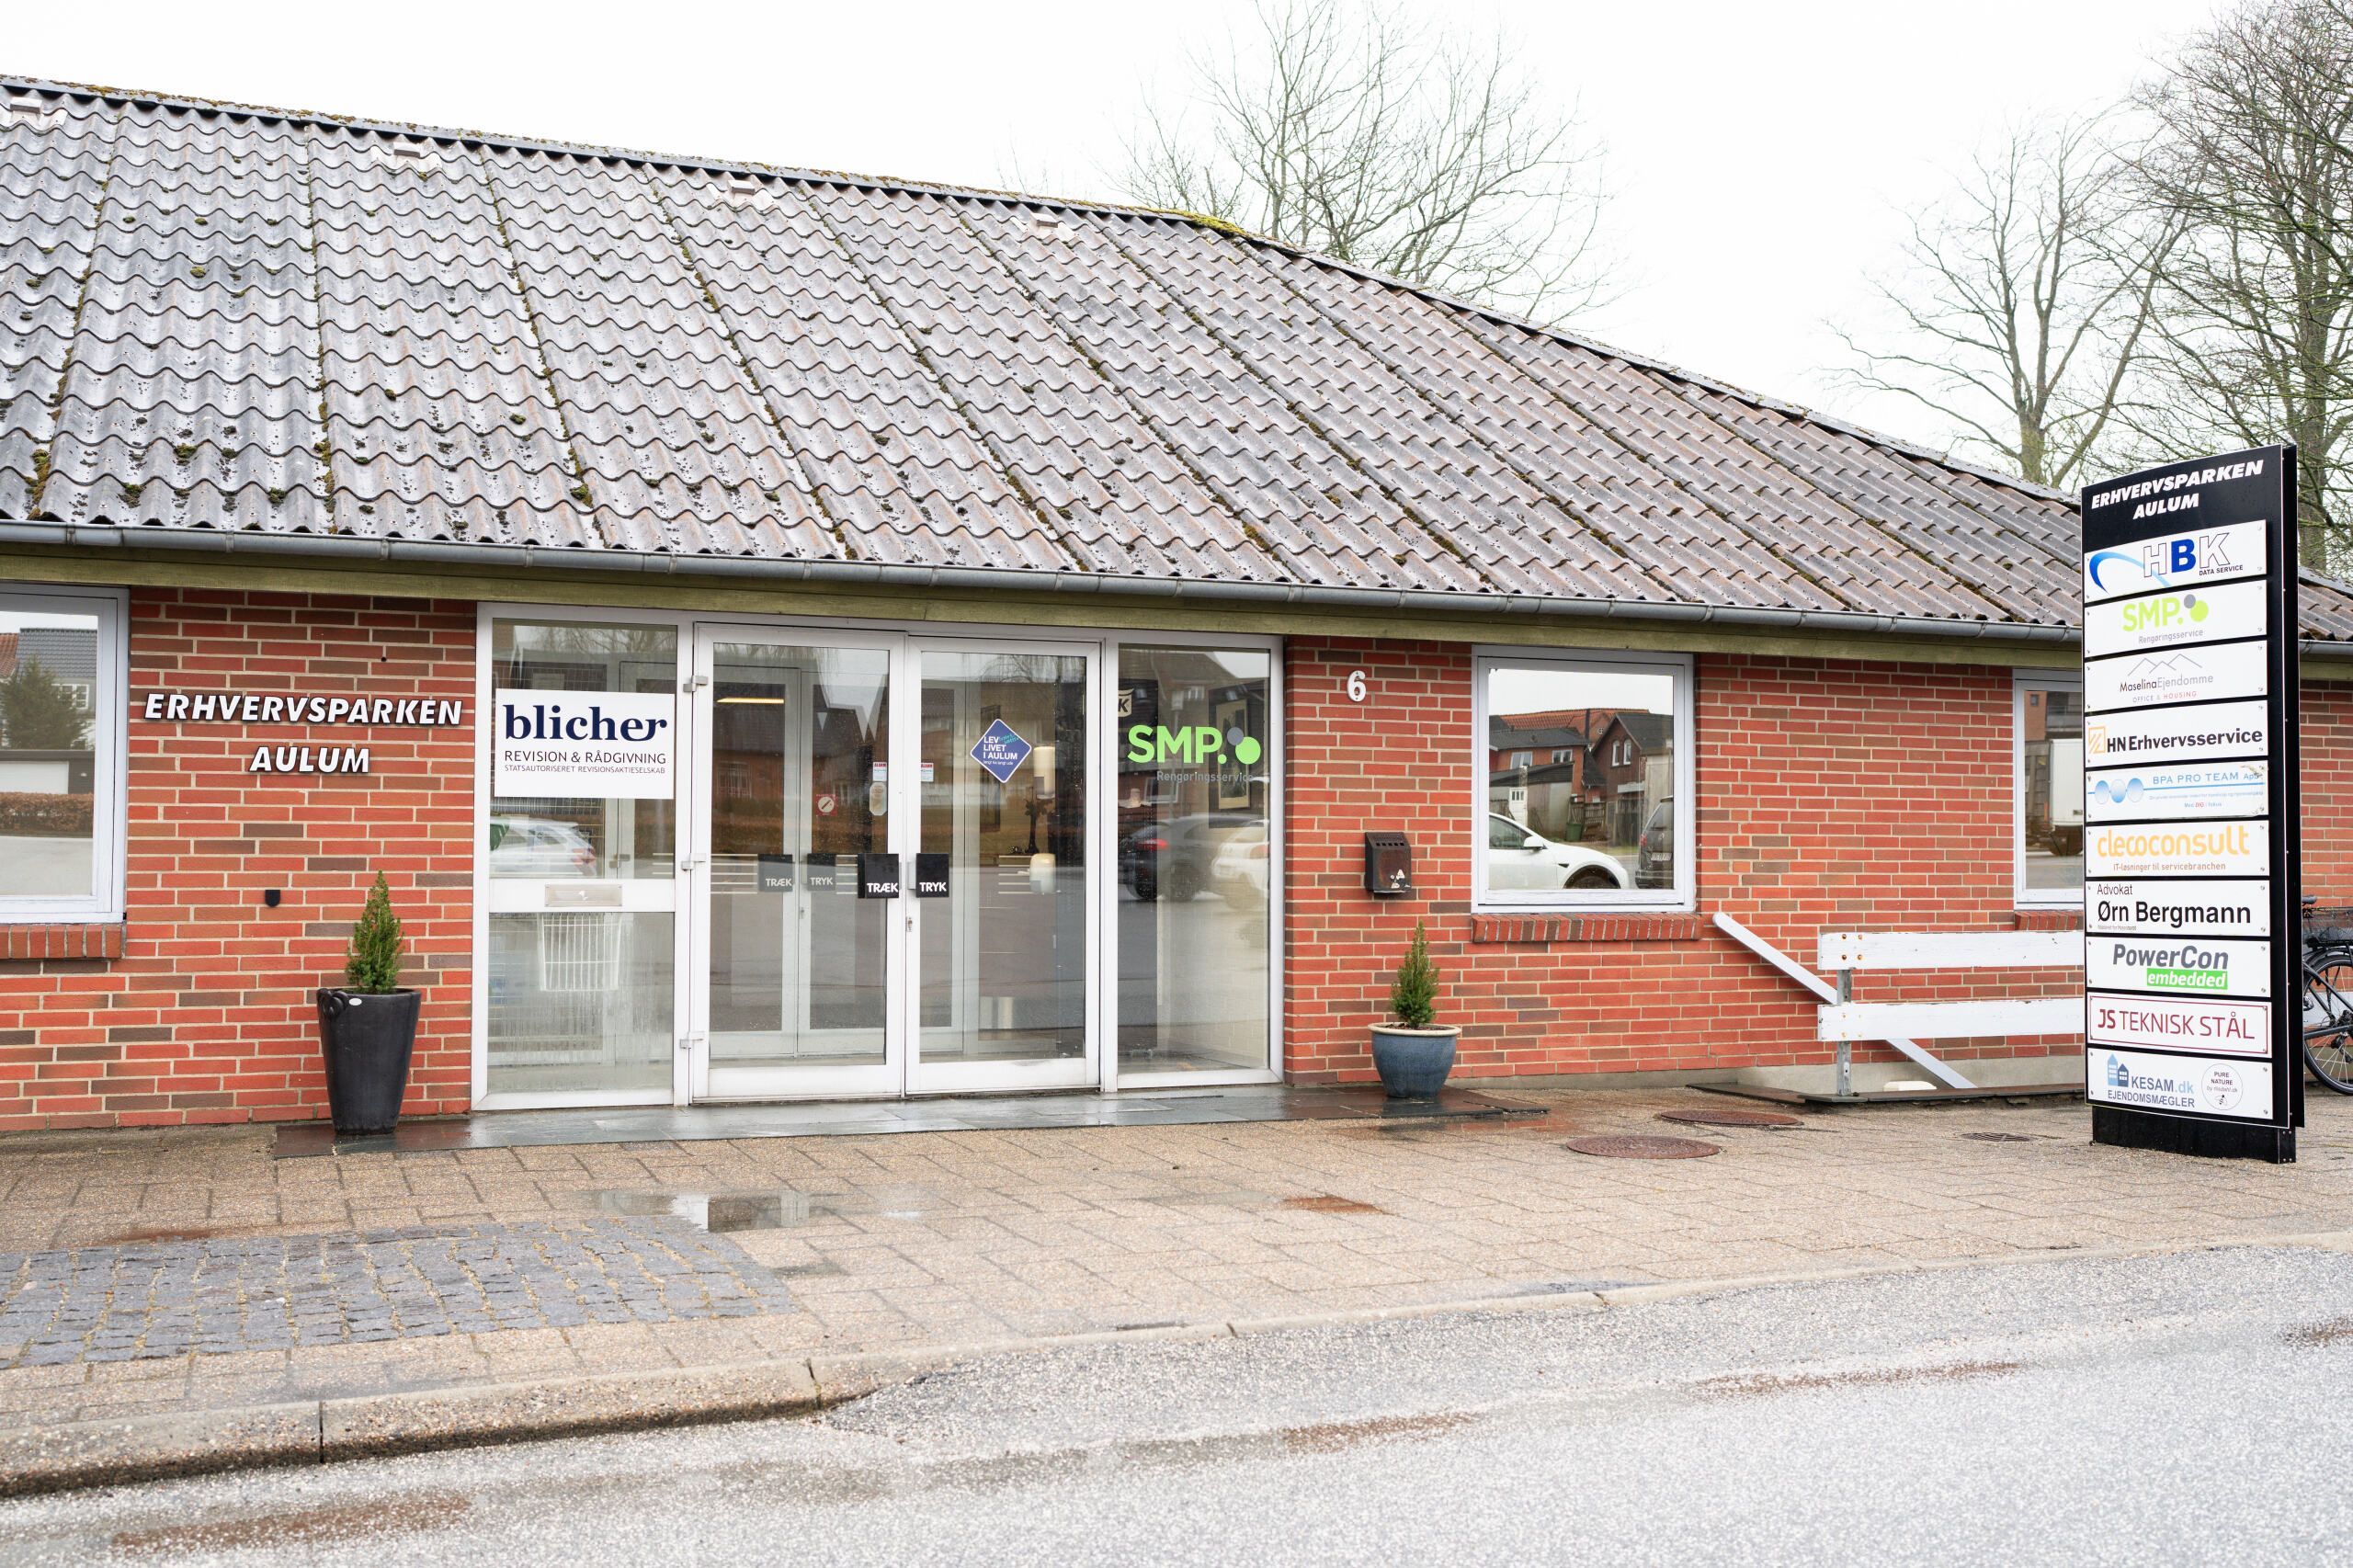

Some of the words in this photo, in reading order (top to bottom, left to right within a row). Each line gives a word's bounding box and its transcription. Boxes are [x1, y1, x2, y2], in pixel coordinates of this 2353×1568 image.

[2091, 460, 2264, 509] ERHVERVSPARKEN
[2132, 493, 2200, 520] AULUM
[2143, 532, 2230, 578] HBK
[2199, 568, 2215, 576] DATA
[2216, 564, 2244, 574] SERVICE
[2139, 629, 2204, 644] Rengøringsservice
[1347, 670, 1367, 702] 6
[2132, 695, 2154, 703] OFFICE
[2163, 690, 2197, 699] HOUSING
[144, 692, 463, 725] ERHVERVSPARKEN
[502, 704, 668, 742] blicher
[983, 744, 1007, 752] LIVET
[2107, 736, 2127, 753] HN
[2129, 728, 2263, 751] Erhvervsservice
[249, 746, 370, 774] AULUM
[505, 750, 567, 763] REVISION
[571, 752, 581, 763] &
[585, 749, 666, 764] RÅDGIVNING
[987, 752, 1017, 760] AULUM
[505, 764, 575, 773] STATSAUTORISERET
[577, 766, 665, 774] REVISIONSAKTIESELSKAB
[1156, 770, 1254, 784] Rengøringsservice
[2153, 776, 2173, 784] BPA
[2177, 774, 2201, 783] PRO
[2205, 772, 2239, 781] TEAM
[2113, 863, 2152, 872] IT-løsninger
[2161, 861, 2226, 870] servicebranchen
[766, 878, 792, 887] TRÆK
[810, 877, 834, 886] TRYK
[867, 882, 899, 893] TRÆK
[919, 881, 947, 892] TRYK
[2097, 883, 2133, 895] Advokat
[2097, 900, 2130, 922] Ørn
[2136, 901, 2251, 929] Bergmann
[2112, 943, 2229, 970] PowerCon
[2147, 971, 2227, 988] embedded
[2097, 1008, 2116, 1029] JS
[2119, 1010, 2195, 1036] TEKNISK
[2200, 1011, 2256, 1040] STÅL
[2108, 1089, 2195, 1108] EJENDOMSMÆGLER
